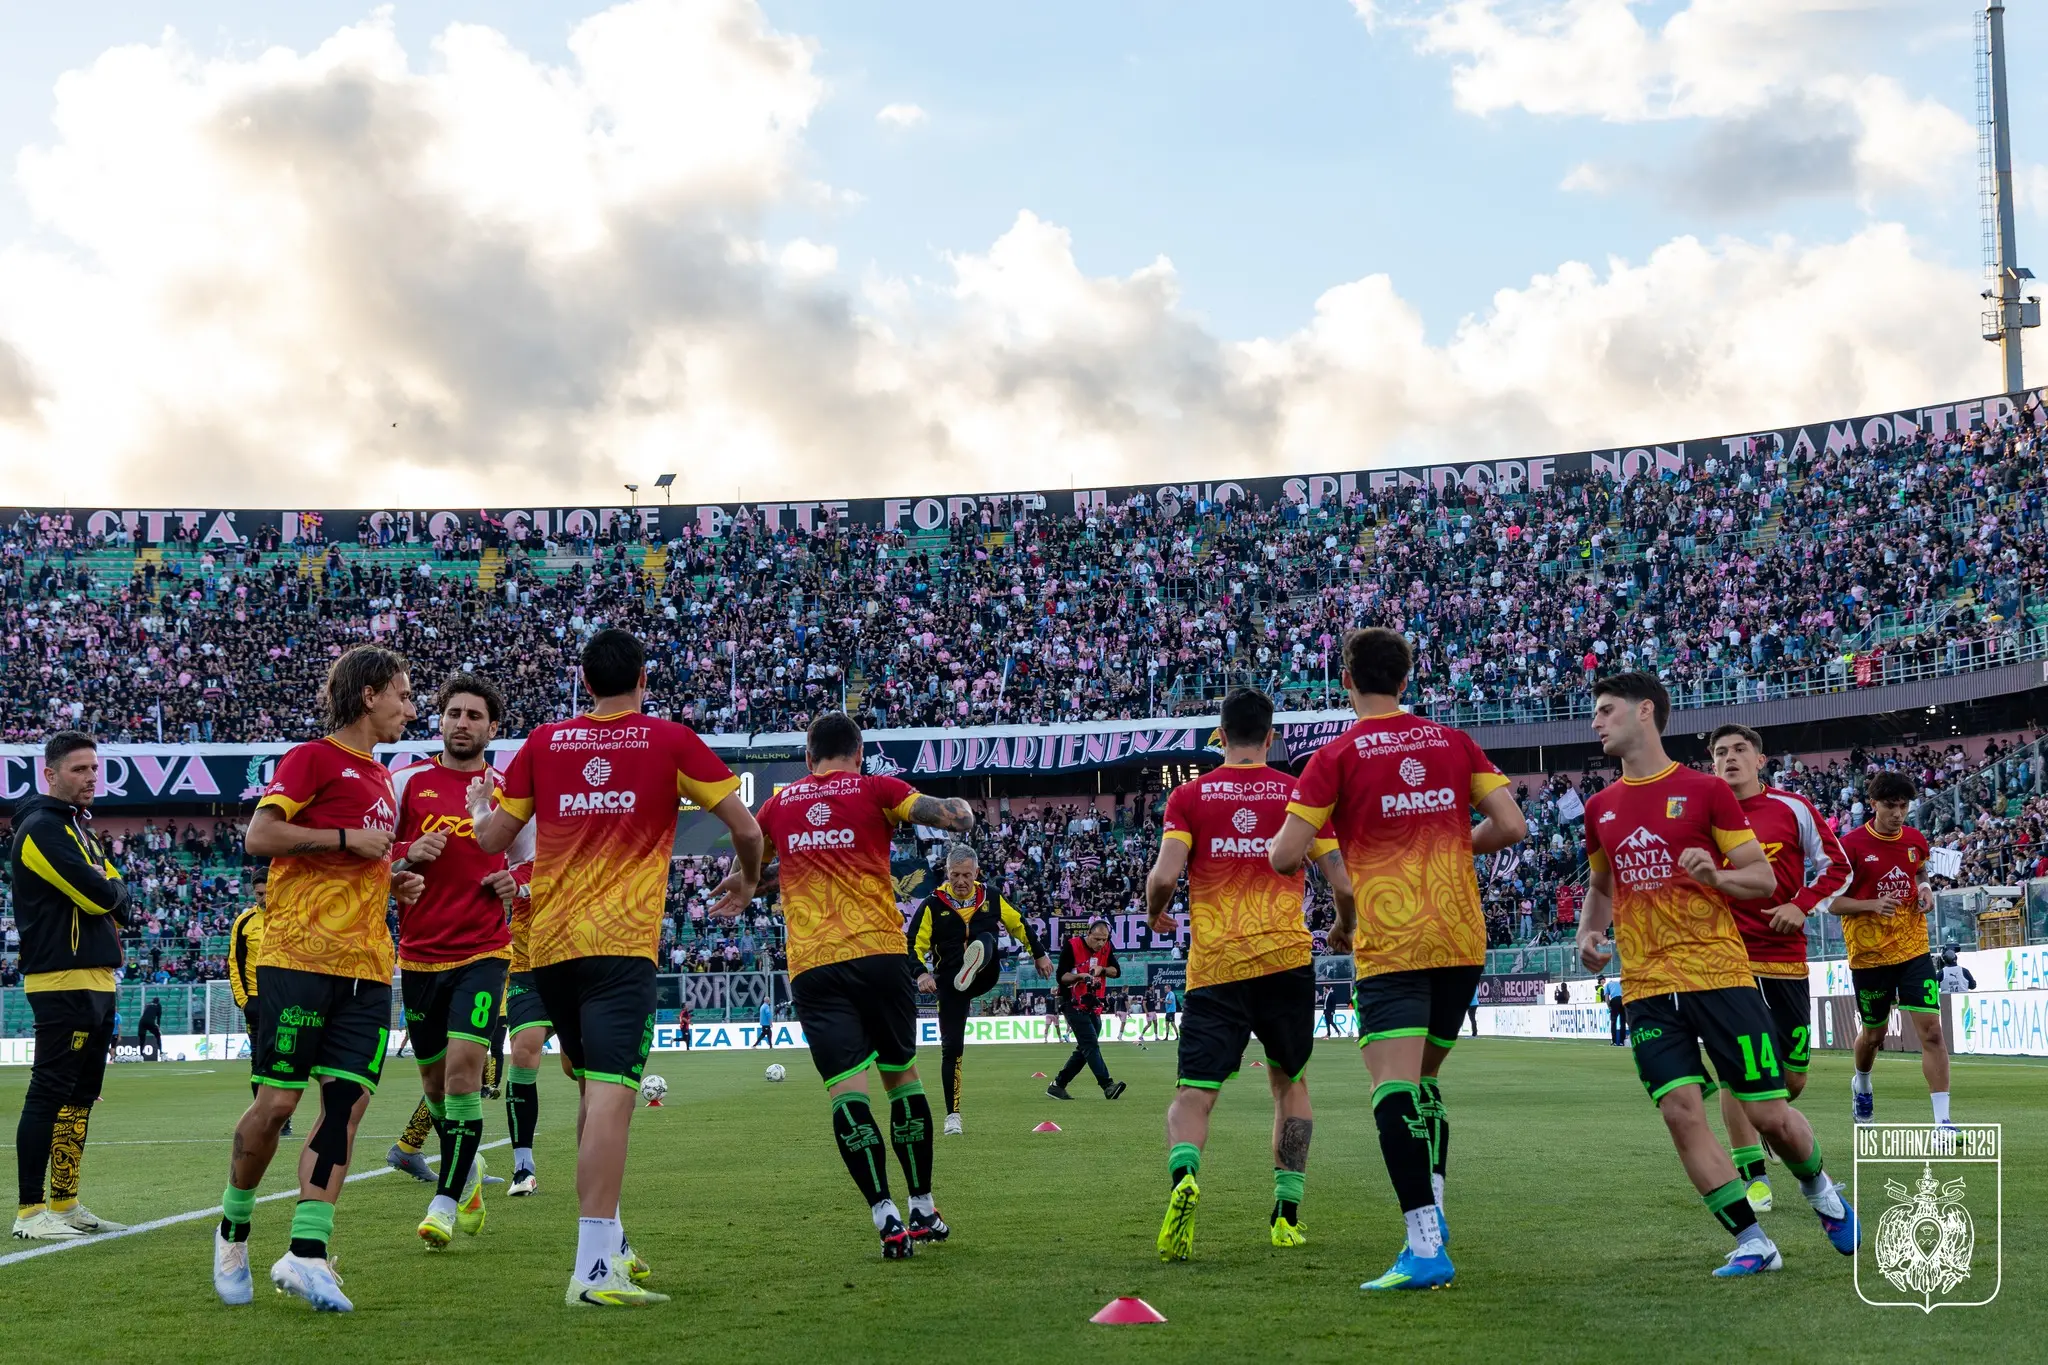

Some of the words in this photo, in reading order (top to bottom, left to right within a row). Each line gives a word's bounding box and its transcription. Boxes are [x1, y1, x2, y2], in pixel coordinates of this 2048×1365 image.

[1591, 444, 1685, 480] NON
[551, 727, 651, 741] EYESPORT
[1354, 725, 1445, 750] EYESPORT
[550, 740, 649, 752] eyesportwear.com
[745, 752, 791, 760] PALERMO
[913, 728, 1197, 774] APPARTENENZA
[1358, 738, 1449, 759] eyesportwear.com
[779, 786, 861, 806] eyesportwear.com
[780, 778, 862, 799] EYESPORT
[1200, 792, 1288, 802] eyesportwear.com
[1201, 781, 1287, 794] EYESPORT
[559, 790, 636, 812] PARCO
[1381, 787, 1455, 812] PARCO
[559, 809, 586, 817] SALUTE
[595, 807, 635, 815] BENESSERE
[1382, 809, 1410, 819] SALUTE
[788, 828, 855, 850] PARCO
[1614, 847, 1674, 870] SANTA
[1620, 865, 1673, 884] CROCE
[1876, 880, 1911, 892] SANTA
[678, 975, 766, 1009] BORGO
[471, 991, 492, 1028] 8
[1737, 1032, 1780, 1082] 14
